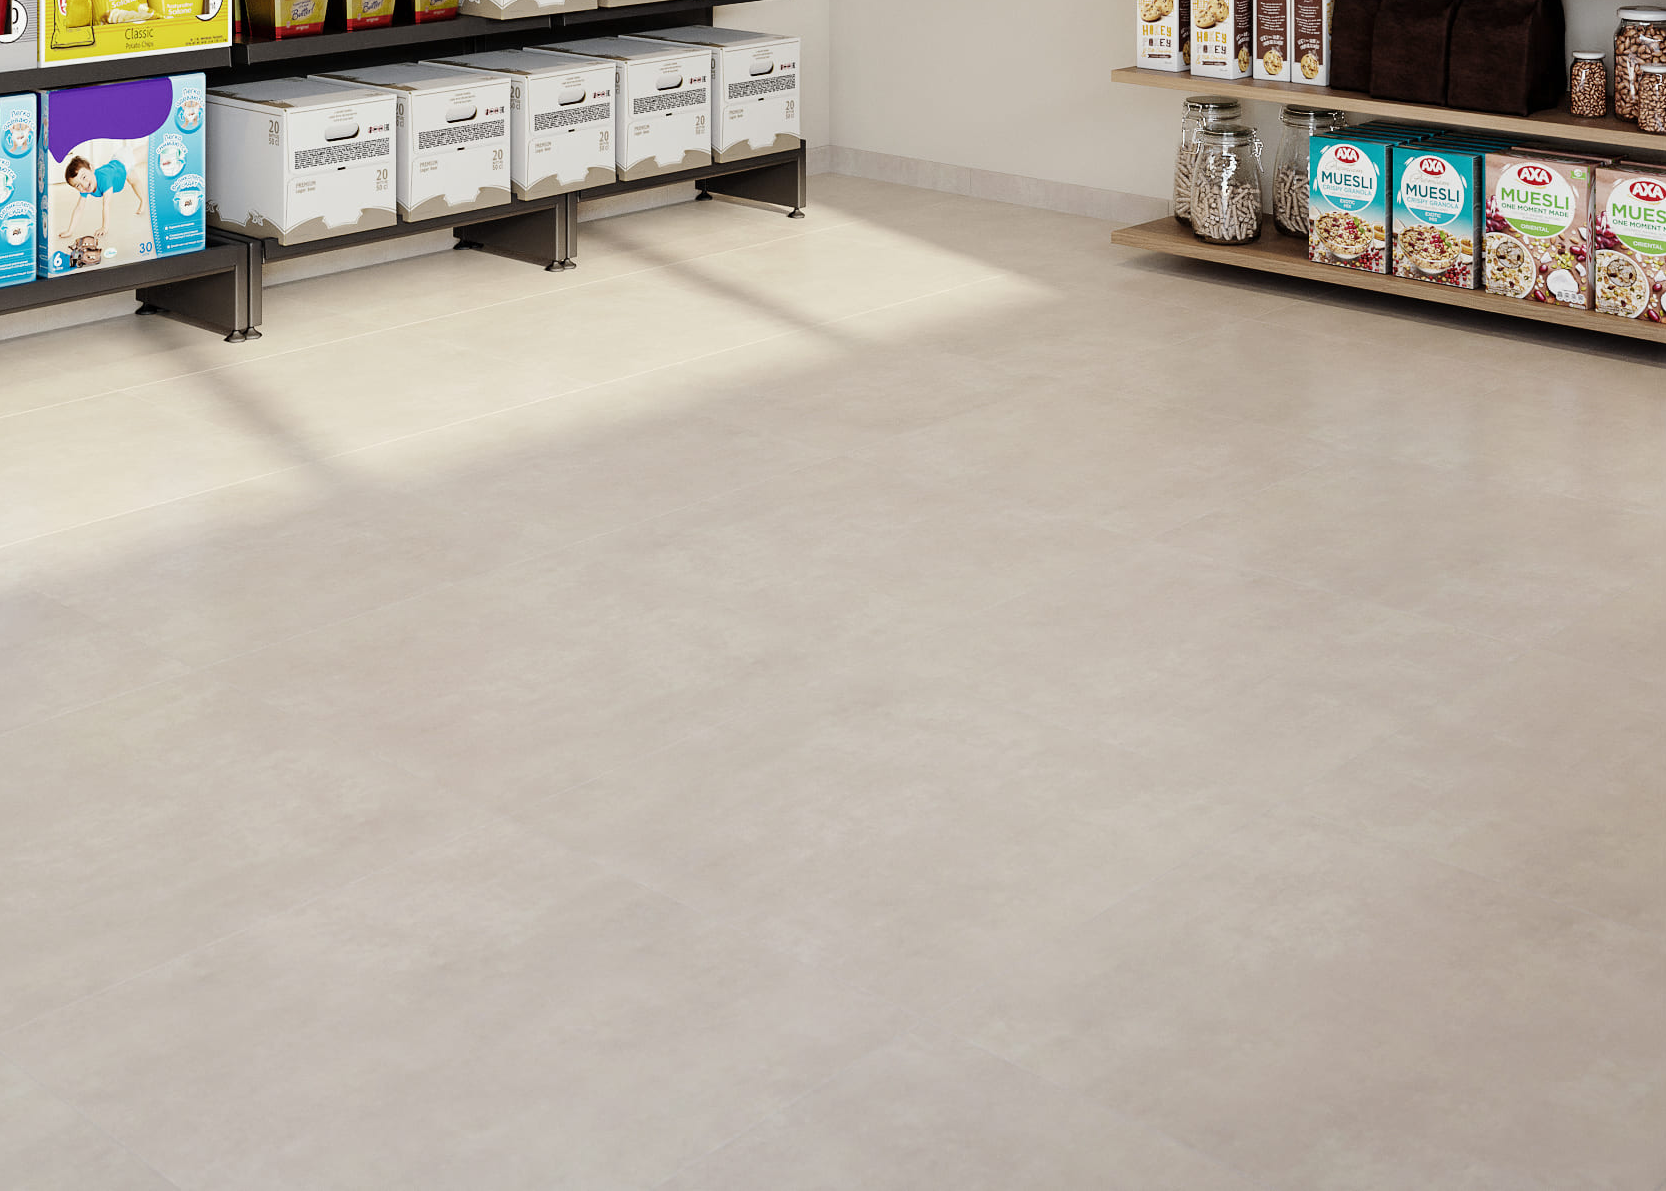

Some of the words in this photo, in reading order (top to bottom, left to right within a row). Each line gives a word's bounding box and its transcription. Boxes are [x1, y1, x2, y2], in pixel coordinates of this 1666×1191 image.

[124, 26, 154, 40] Classic
[1142, 24, 1172, 37] HOKEY
[1196, 31, 1227, 44] HOKEY
[785, 100, 794, 110] 20
[695, 115, 705, 125] 20
[269, 120, 279, 134] 20
[599, 131, 609, 142] 20
[492, 149, 503, 161] 20
[1336, 147, 1358, 160] AXA
[1422, 159, 1444, 173] AXA
[376, 168, 388, 181] 20
[1321, 171, 1373, 189] MUESLI
[1519, 166, 1550, 185] AXA
[1344, 187, 1372, 196] GRANOLA
[1406, 183, 1459, 202] MUESLI
[1632, 182, 1665, 201] AXA
[1429, 200, 1459, 209] GRANOLA
[1501, 187, 1569, 210] MUESLI
[1501, 202, 1516, 210] ONE
[1517, 205, 1547, 214] MOMENT
[1548, 209, 1569, 218] MADE
[1520, 223, 1550, 233] ORIENTAL
[1612, 219, 1628, 227] ONE
[1629, 221, 1661, 231] MOMENT
[139, 241, 153, 253] 30
[1632, 240, 1663, 250] ORIENTAL
[54, 252, 63, 267] 6
